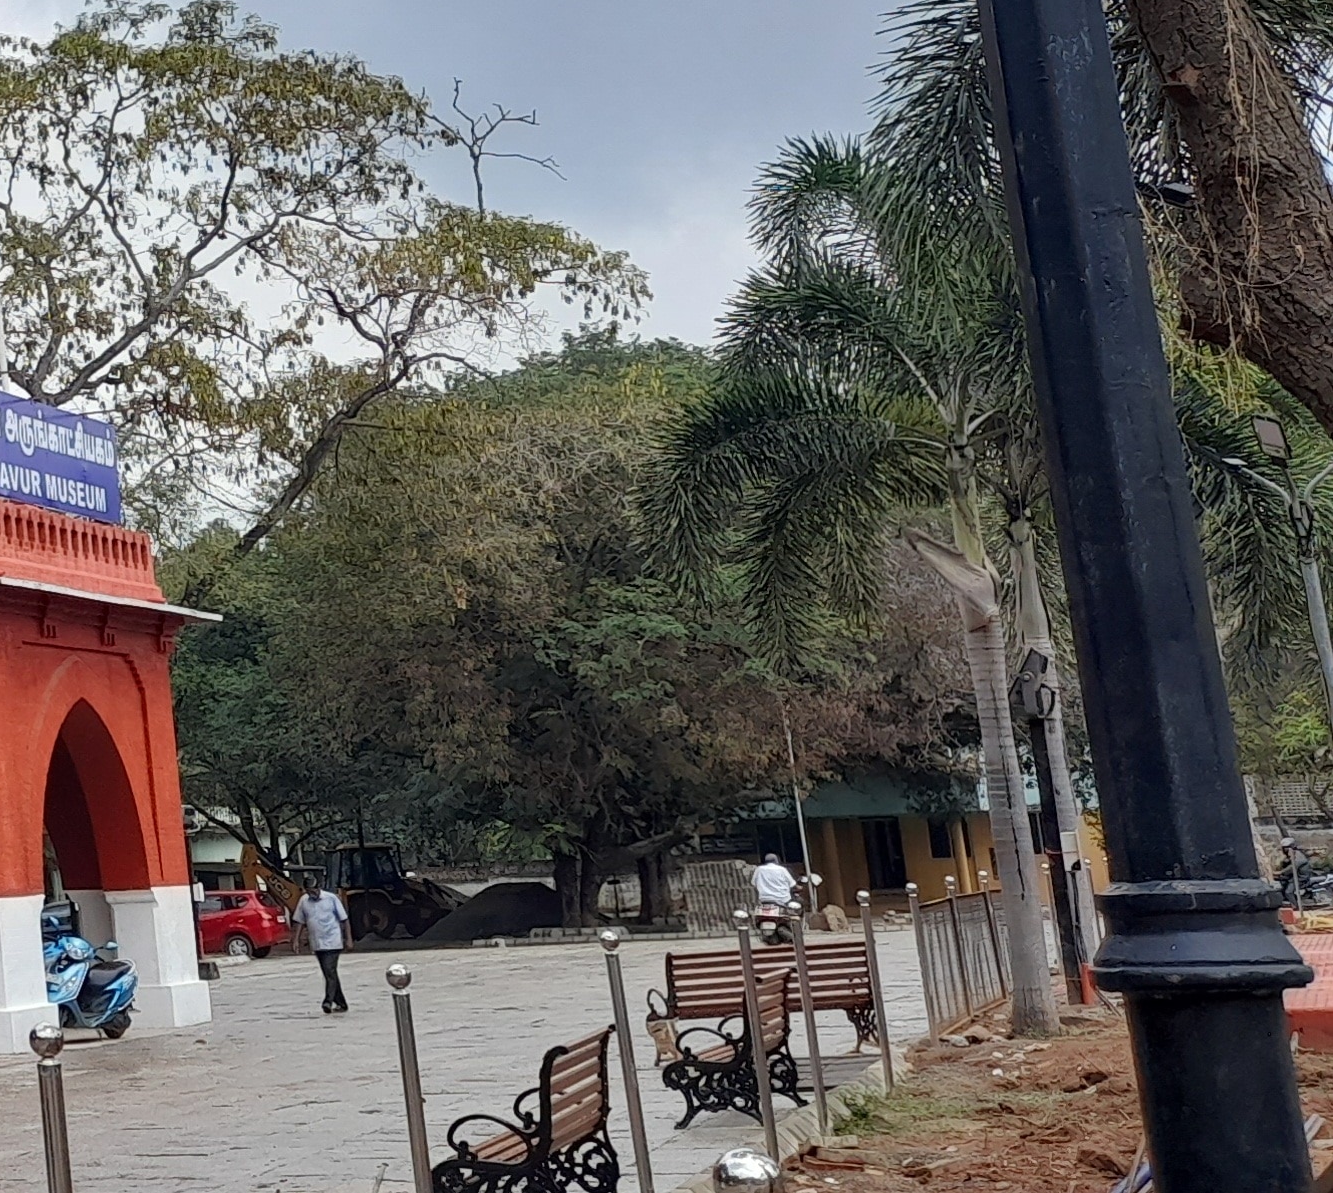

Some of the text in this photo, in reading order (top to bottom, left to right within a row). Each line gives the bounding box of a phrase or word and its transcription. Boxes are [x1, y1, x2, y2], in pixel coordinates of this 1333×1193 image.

[5, 409, 114, 467] அருங்காட்சியகம்
[45, 473, 107, 513] MUSEUM
[267, 876, 291, 899] JCB
